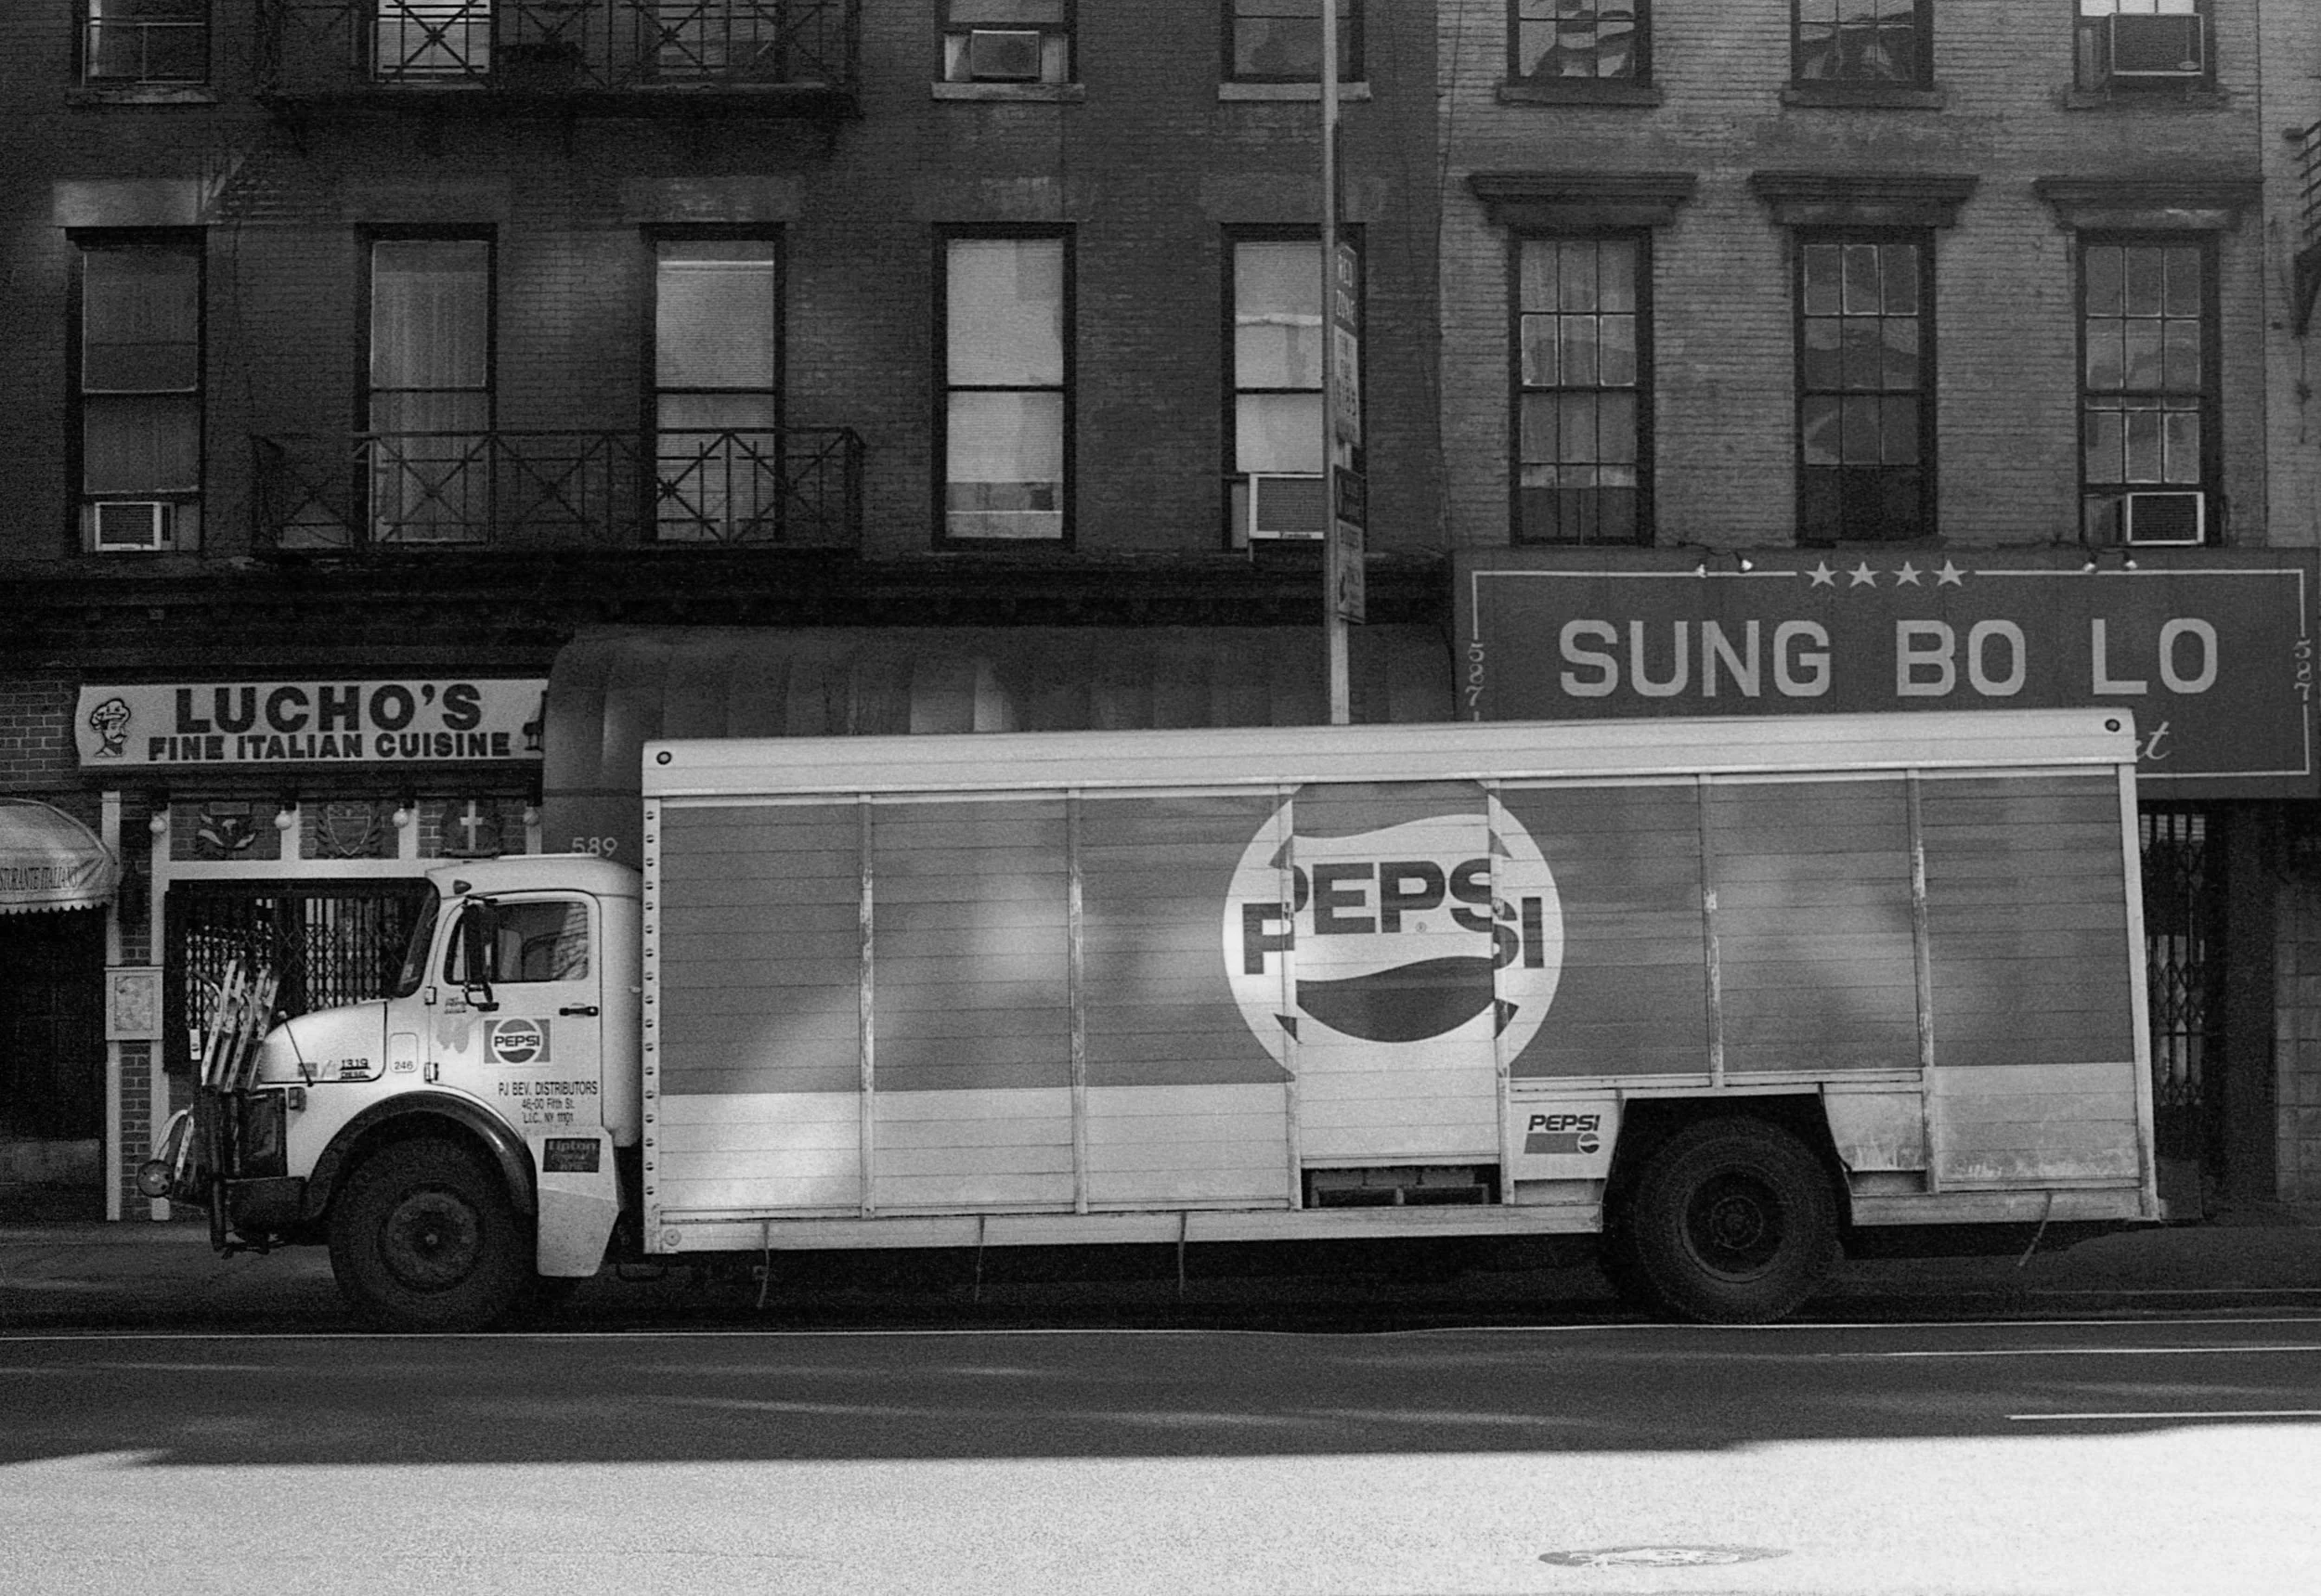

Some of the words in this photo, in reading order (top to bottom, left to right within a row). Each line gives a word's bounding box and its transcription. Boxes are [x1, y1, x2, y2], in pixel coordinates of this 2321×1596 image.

[1559, 619, 1832, 697] SUNG
[1896, 619, 2027, 697] BO
[2091, 617, 2219, 695] LO
[1465, 642, 1485, 707] 587
[2292, 639, 2312, 701] 587
[175, 683, 482, 734] LUCHO'S
[148, 735, 223, 760] FINE
[236, 733, 363, 759] ITALIAN
[374, 732, 511, 759] CUISINE
[571, 837, 618, 857] 589
[1242, 858, 1545, 975] PEPSI
[494, 1035, 540, 1047] PEPSI
[341, 1058, 370, 1070] 1319
[394, 1060, 414, 1070] 246
[498, 1082, 510, 1096] PJ
[512, 1081, 533, 1096] BEV.
[535, 1080, 598, 1096] DISTRIBUTORS
[1528, 1114, 1601, 1132] PEPSI
[548, 1140, 597, 1152] Lipton
